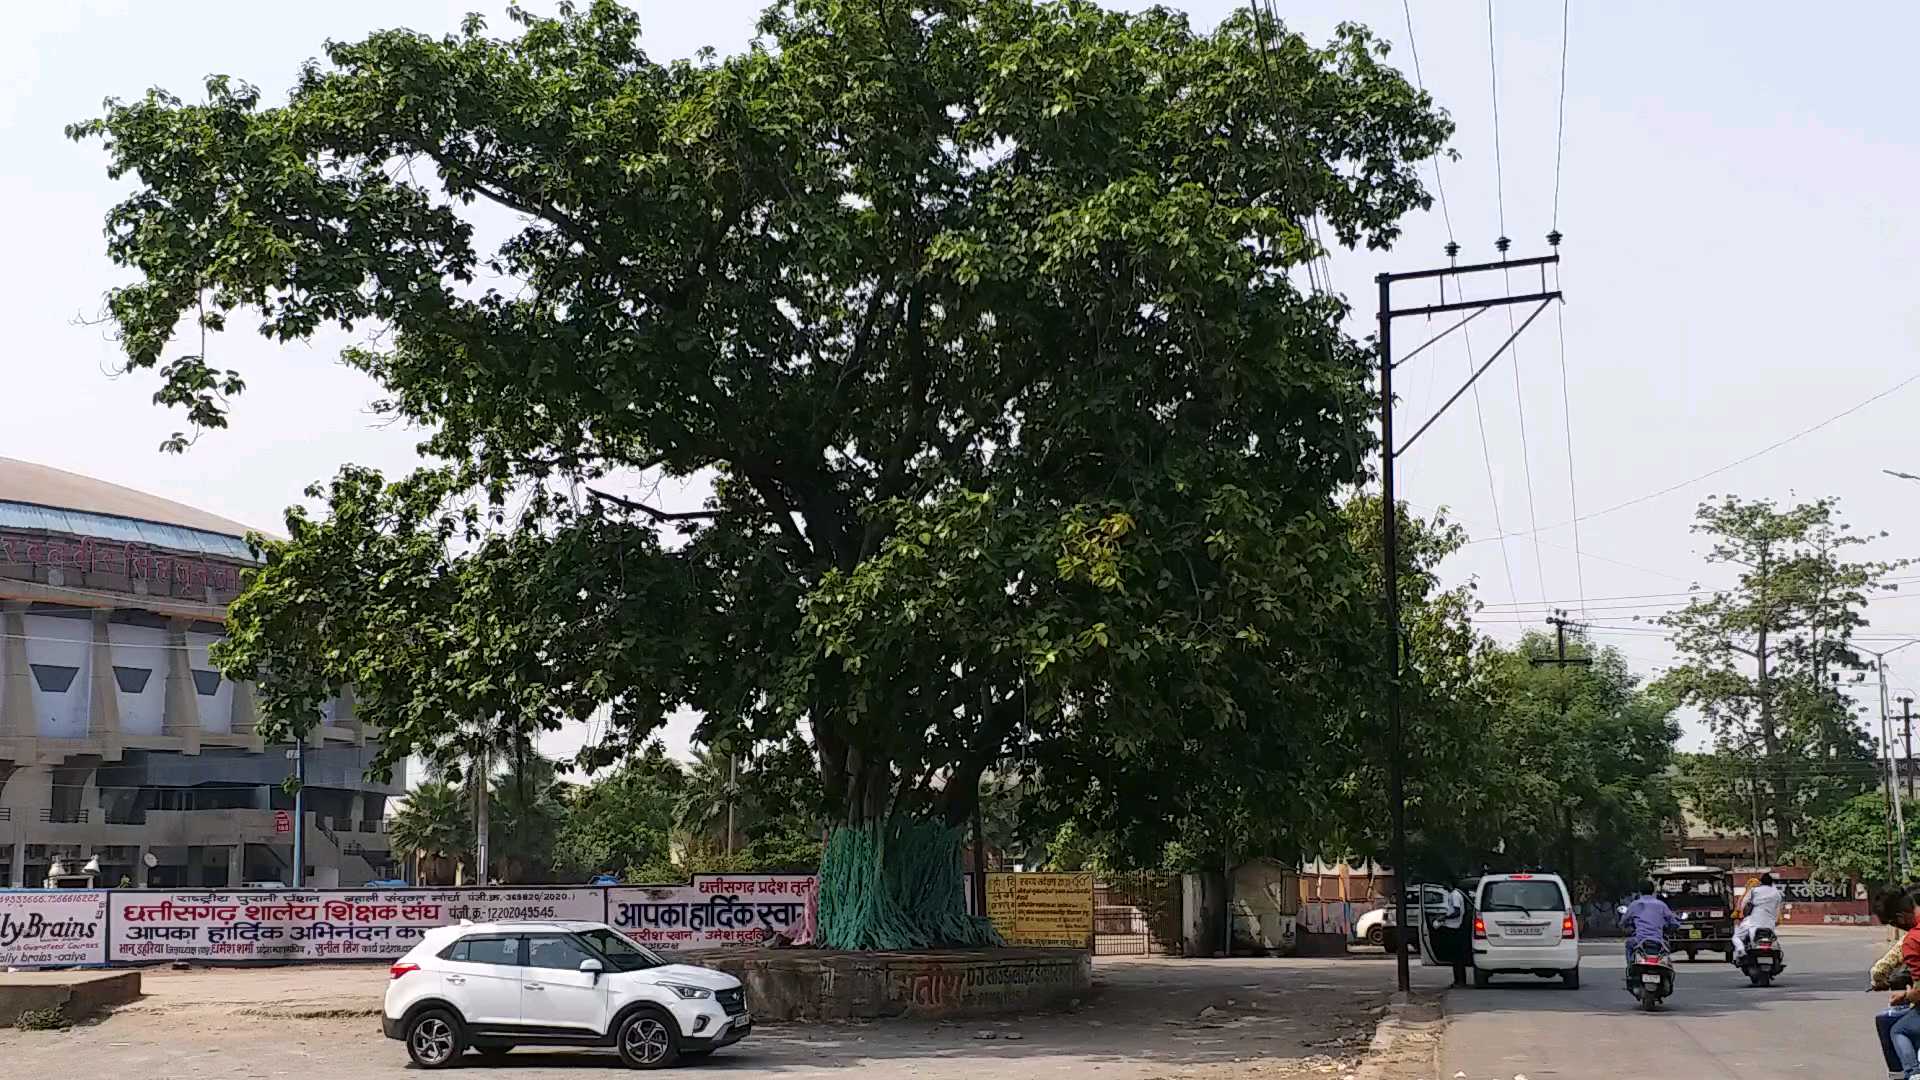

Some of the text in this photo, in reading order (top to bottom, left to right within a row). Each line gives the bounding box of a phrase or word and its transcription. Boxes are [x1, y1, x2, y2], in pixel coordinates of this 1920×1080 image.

[758, 879, 788, 894] प्रदेश
[245, 903, 318, 921] शालेय
[324, 901, 398, 922] शिक्षक
[402, 902, 442, 921] संघ
[614, 903, 689, 928] आपका
[691, 895, 756, 932] हार्दिक
[126, 926, 199, 940] आपका
[208, 921, 283, 943] हार्दिक
[290, 921, 392, 940] अभिनंदन
[704, 929, 735, 941] उमेश
